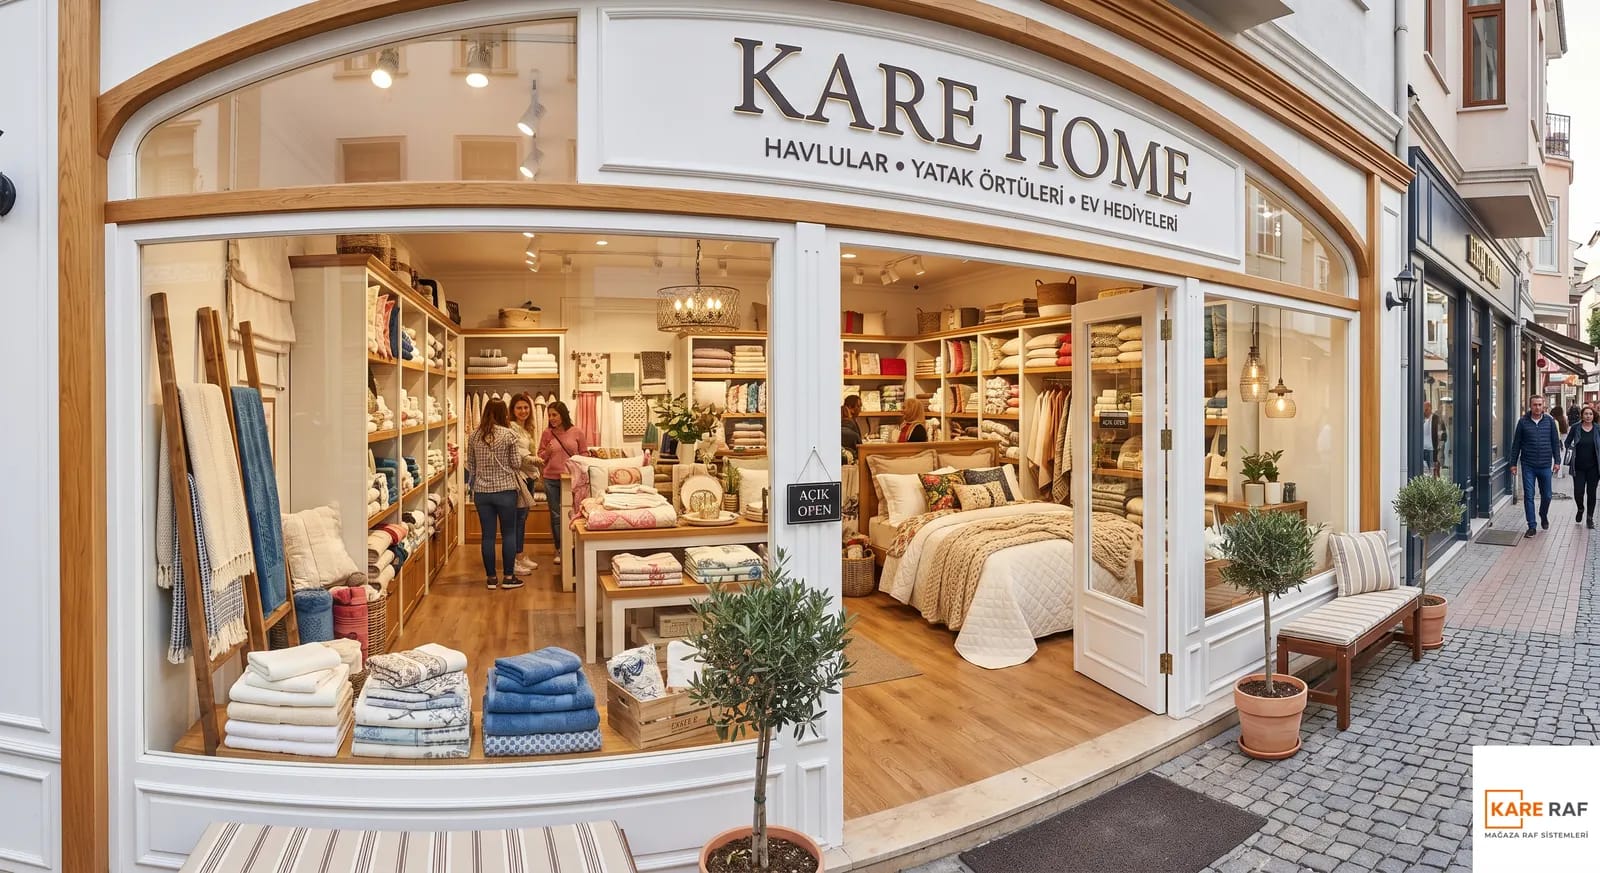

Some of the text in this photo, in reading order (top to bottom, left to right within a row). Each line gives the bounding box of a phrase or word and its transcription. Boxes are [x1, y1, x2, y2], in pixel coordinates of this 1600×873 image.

[733, 37, 1192, 206] KARE HOME
[765, 137, 1178, 232] HAVLULAR YATAK ÖRTÜLERİ EV HEDİYELERİ
[798, 504, 831, 517] OPEN
[800, 488, 830, 502] AÇIK
